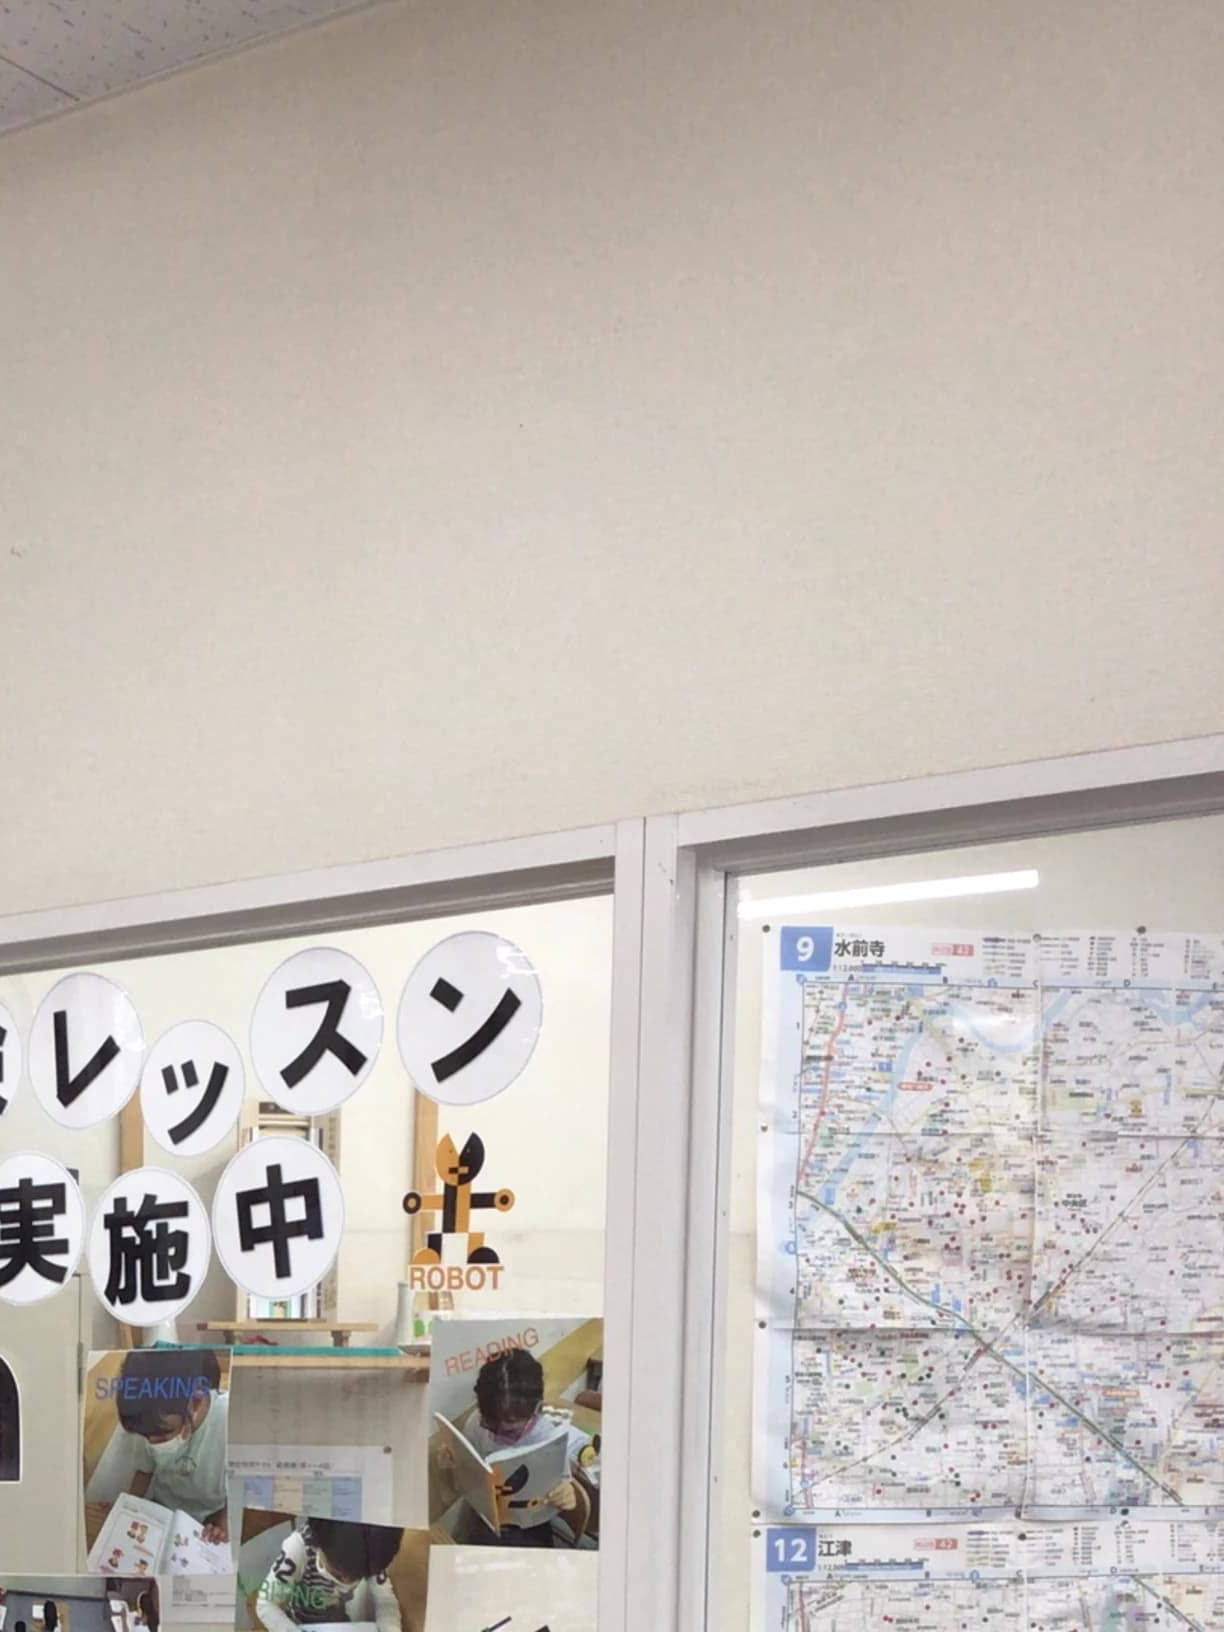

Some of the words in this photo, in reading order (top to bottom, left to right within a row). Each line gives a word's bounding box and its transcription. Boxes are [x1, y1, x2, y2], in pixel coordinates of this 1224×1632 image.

[796, 936, 815, 962] 9
[834, 940, 885, 958] 水前寺
[409, 1265, 504, 1290] ROBOT
[445, 1327, 540, 1376] READING
[95, 1375, 211, 1401] SPEAKING
[775, 1538, 808, 1563] 12
[818, 1540, 852, 1557] 江津
